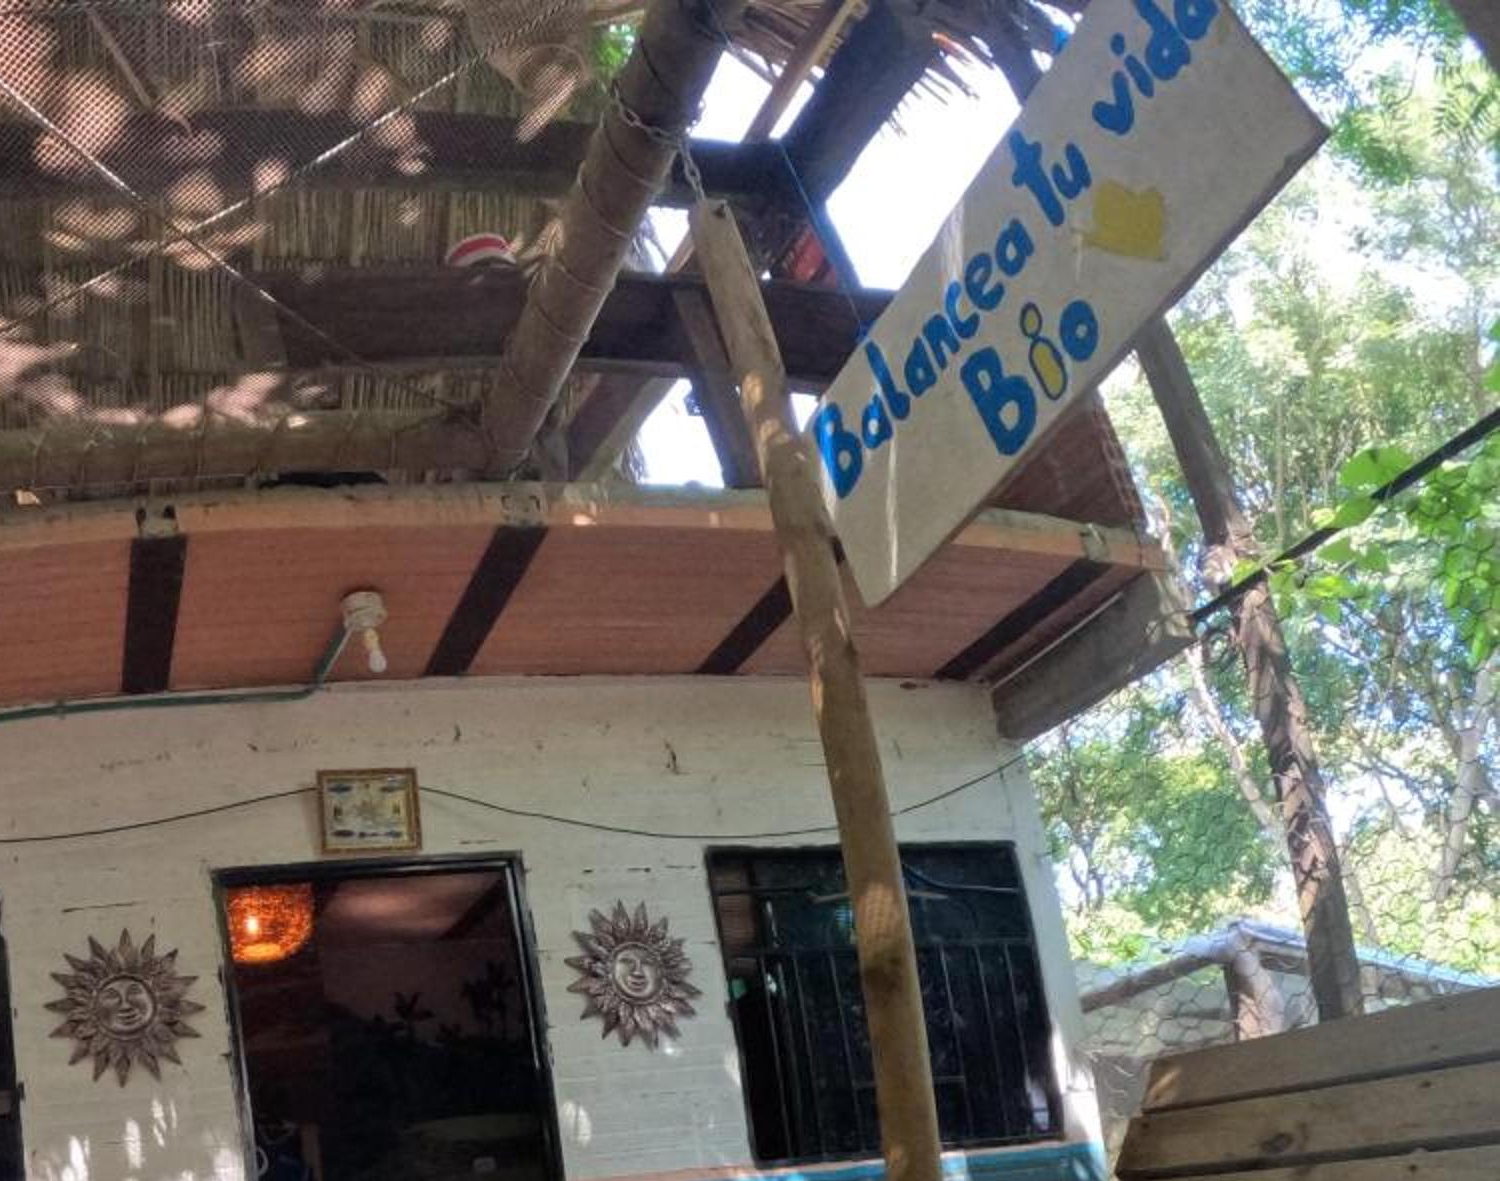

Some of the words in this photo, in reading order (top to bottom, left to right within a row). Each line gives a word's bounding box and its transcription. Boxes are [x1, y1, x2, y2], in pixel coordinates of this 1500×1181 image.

[813, 219, 1034, 499] Balancea
[1009, 129, 1092, 227] tu
[1092, 0, 1220, 135] vida
[961, 300, 1099, 456] Bio
